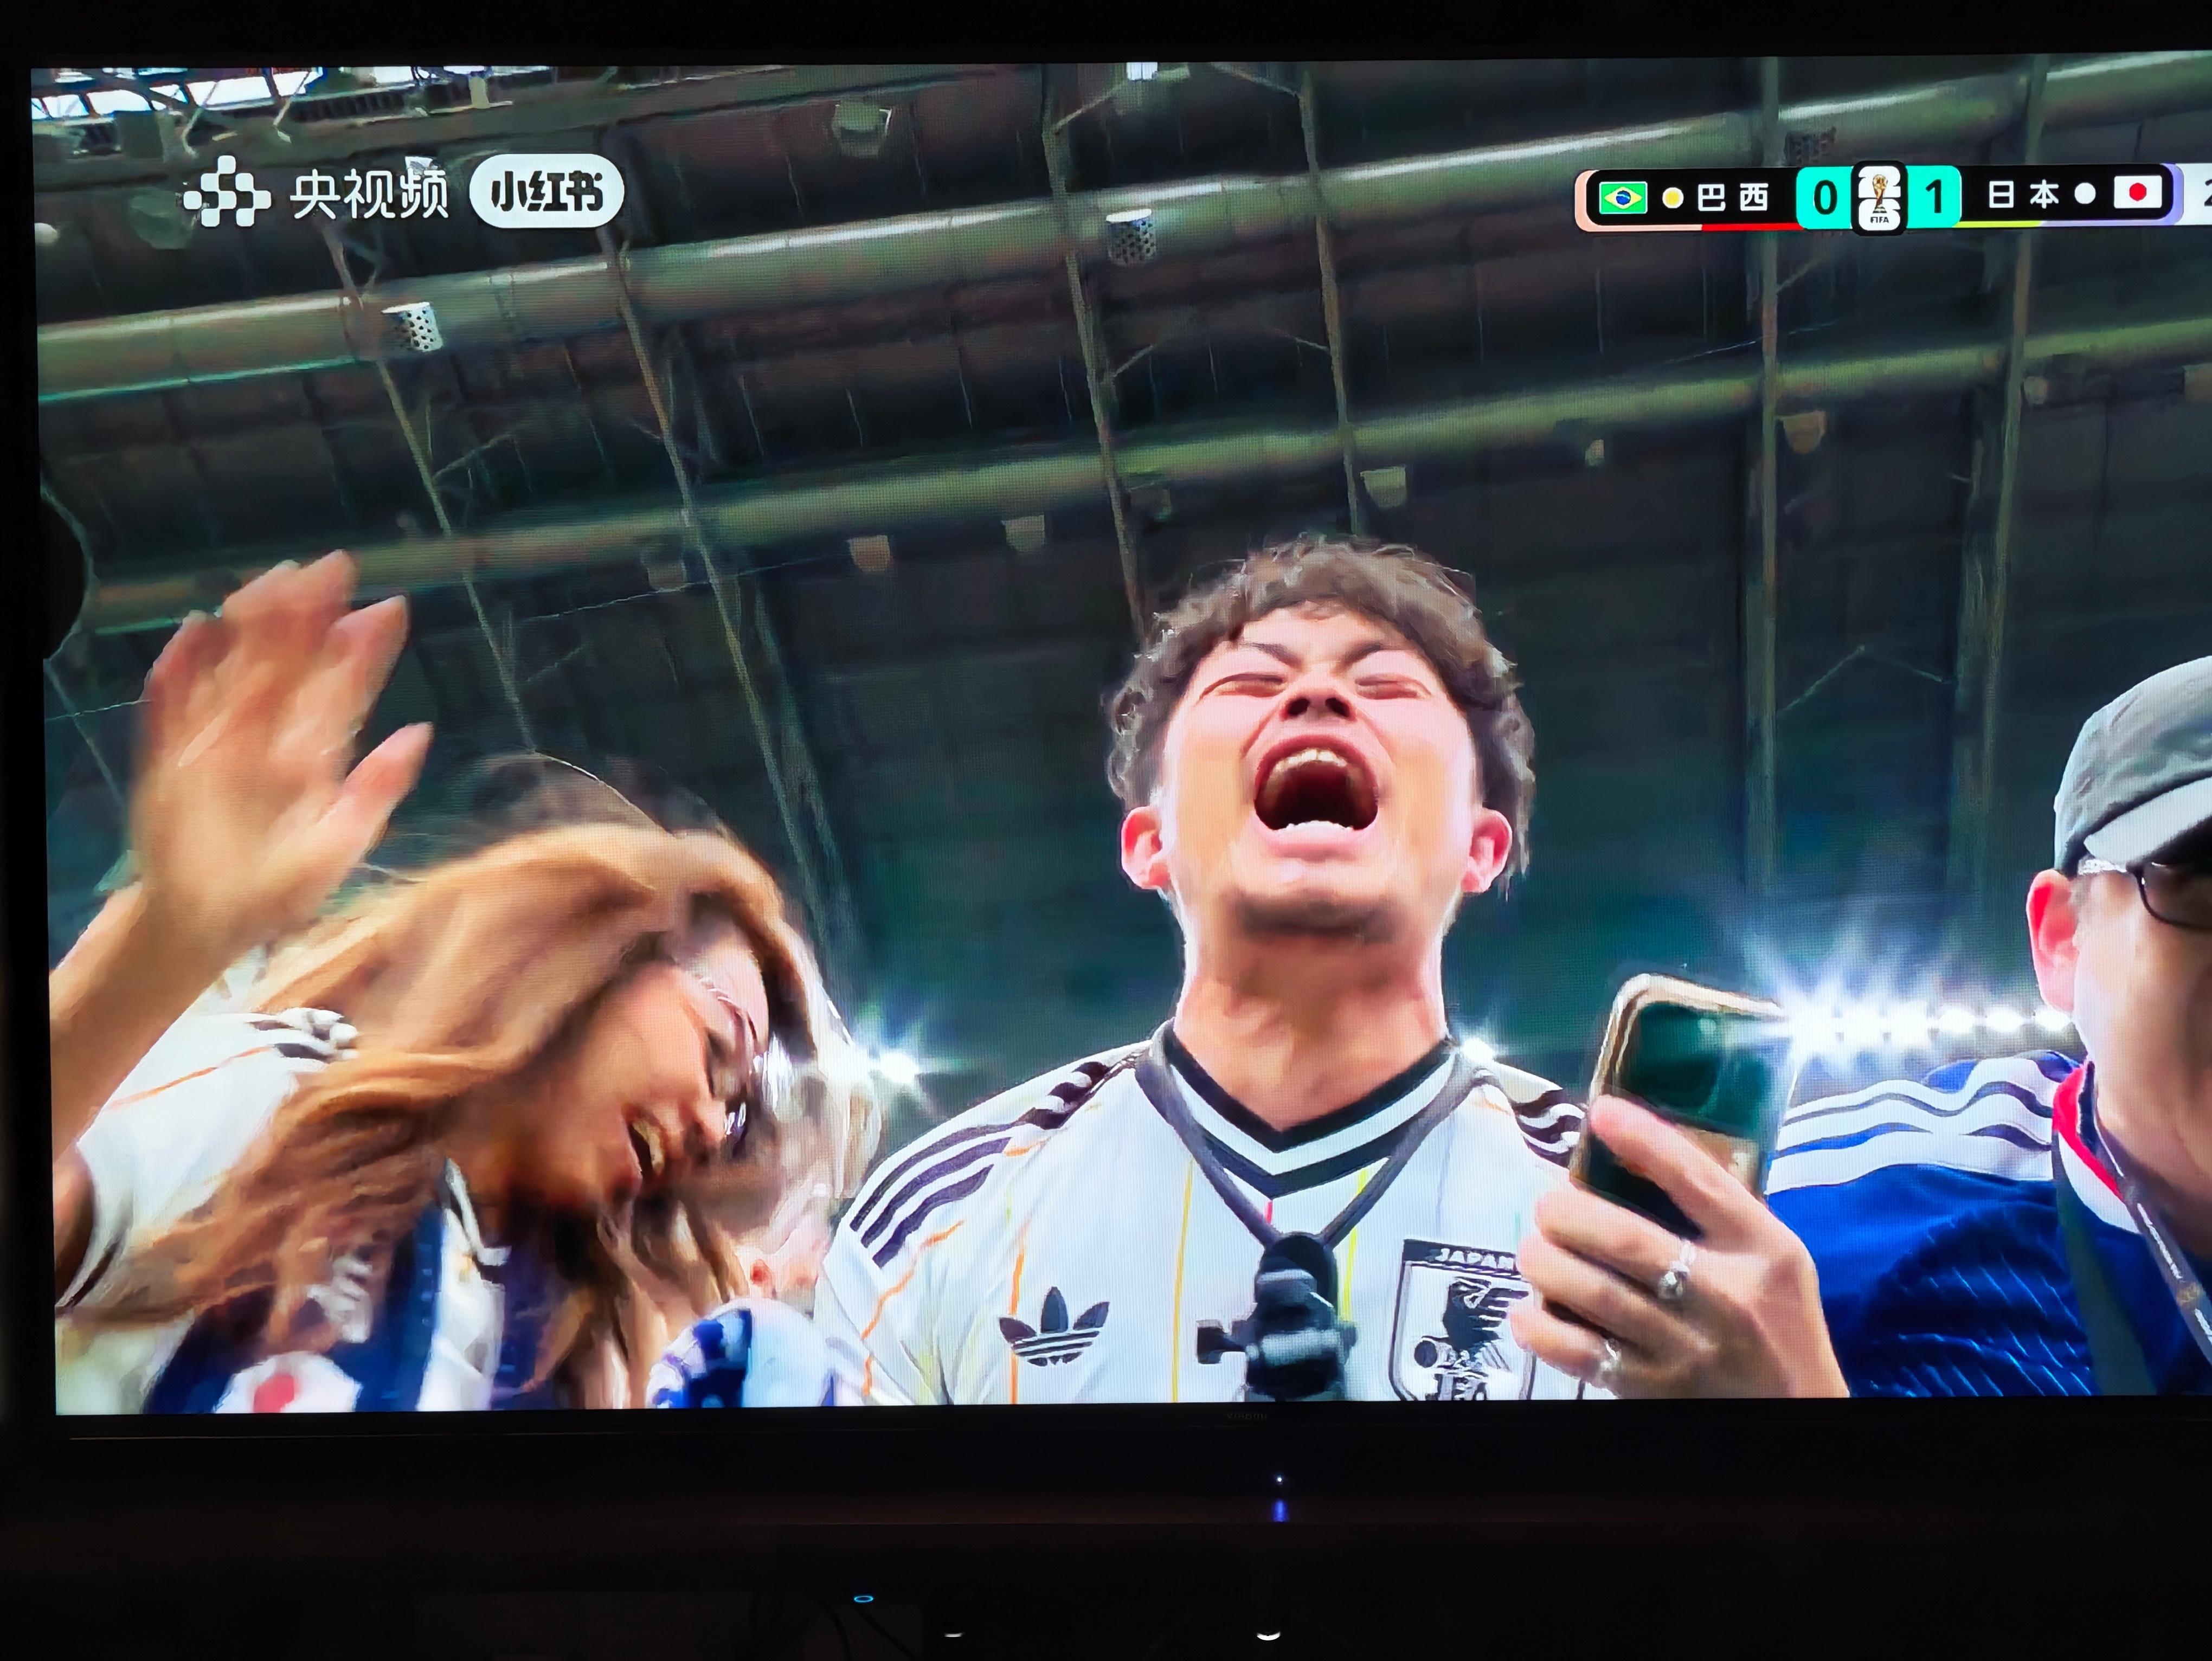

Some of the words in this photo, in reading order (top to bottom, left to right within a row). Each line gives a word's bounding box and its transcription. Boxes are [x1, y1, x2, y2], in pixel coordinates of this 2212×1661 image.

[289, 169, 449, 220] 央视频
[491, 170, 603, 212] 小红书
[1697, 183, 1770, 211] 巴西
[1814, 179, 1837, 215] 0
[1925, 179, 1941, 214] 1
[1989, 179, 2059, 209] 日本
